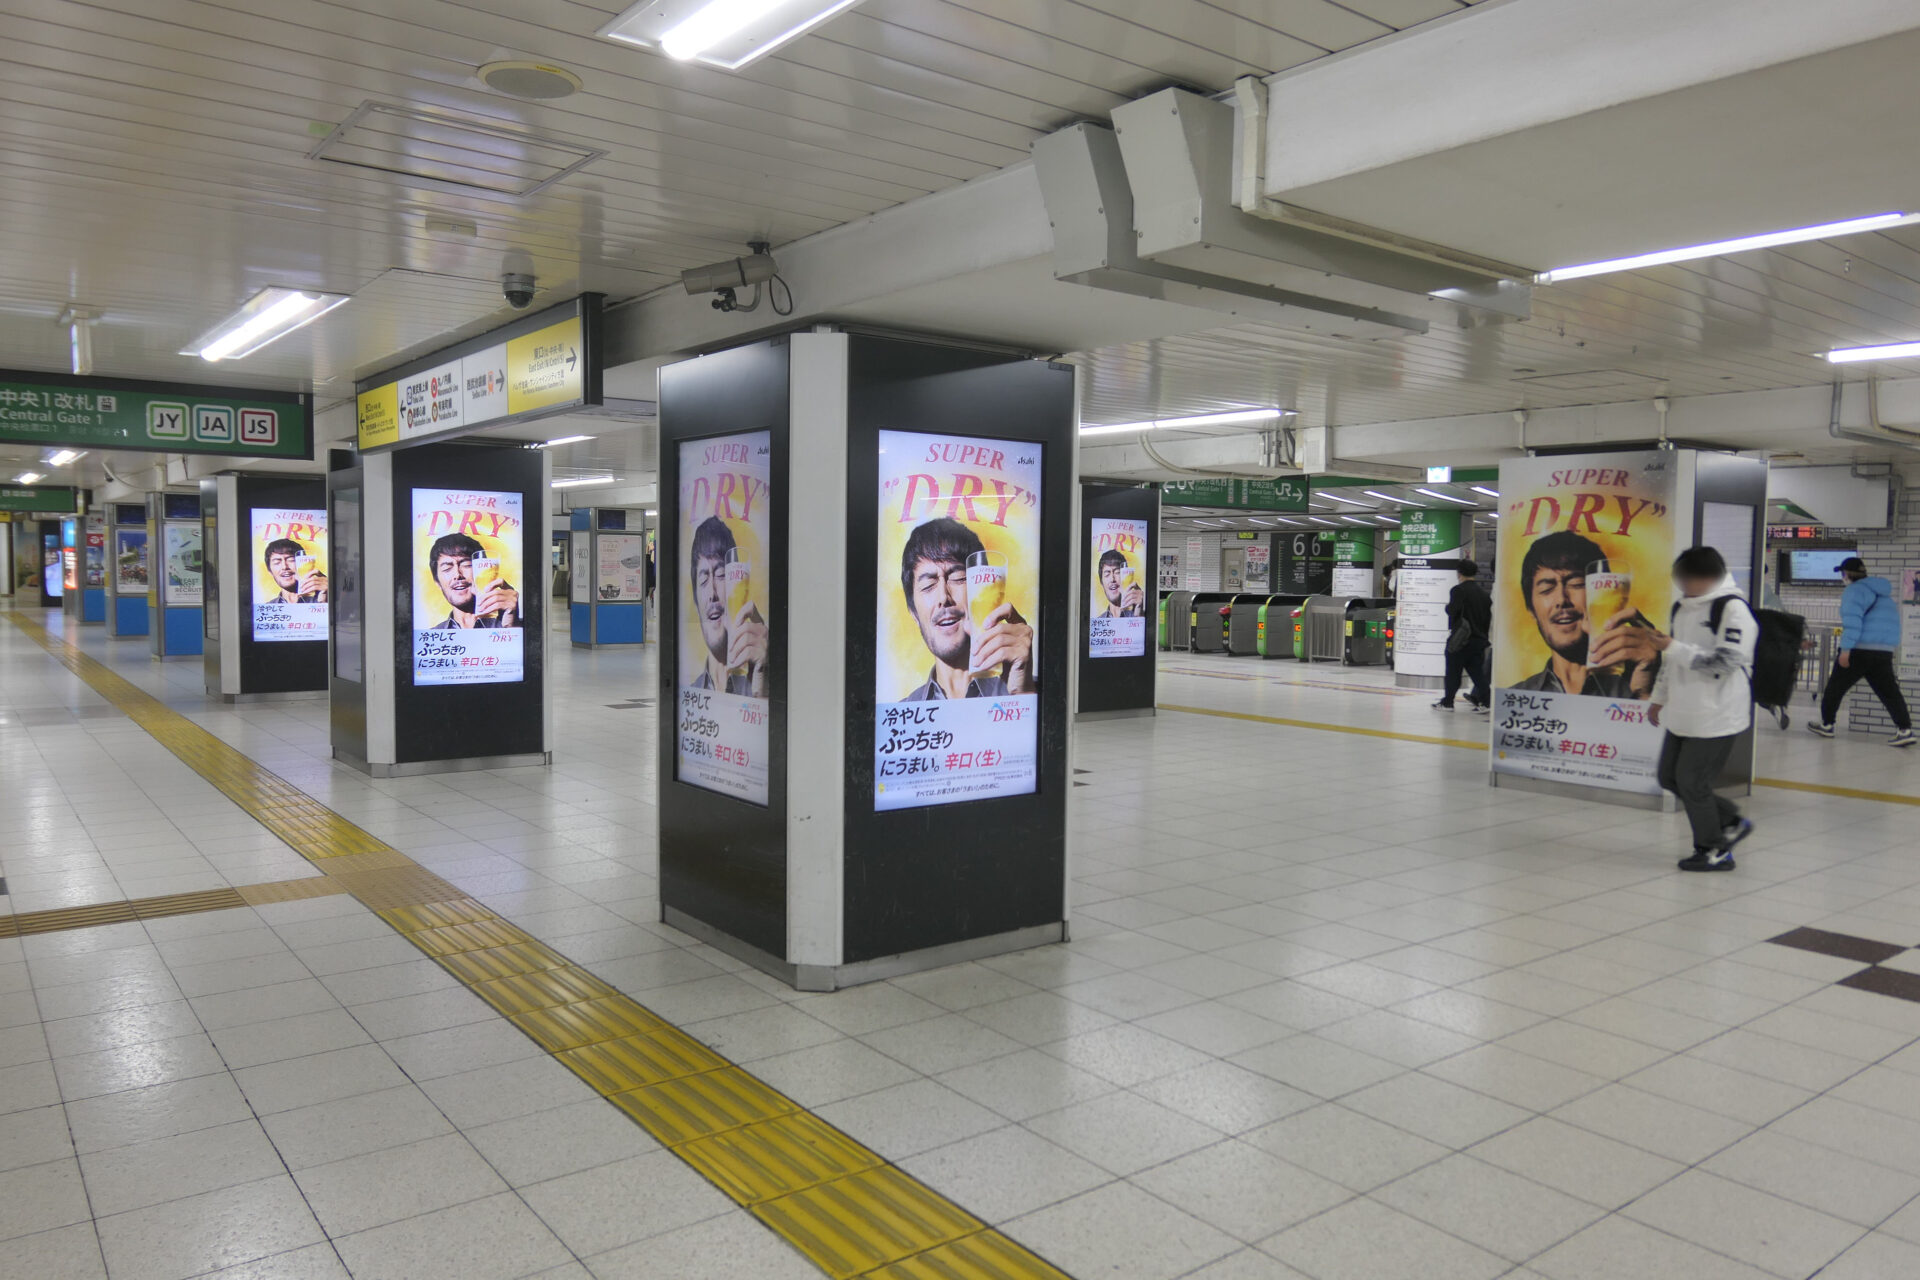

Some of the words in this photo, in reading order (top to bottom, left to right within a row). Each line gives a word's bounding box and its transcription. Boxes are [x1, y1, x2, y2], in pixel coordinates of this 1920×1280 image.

[0, 389, 94, 410] 中央1改札
[0, 408, 52, 422] Central
[57, 412, 90, 424] Gate
[96, 414, 103, 424] 1
[156, 412, 180, 429] JY
[201, 416, 226, 432] JA
[248, 418, 268, 434] JS
[702, 444, 749, 466] SUPER
[926, 443, 1004, 472] SUPER
[1018, 456, 1035, 466] Asahi
[1548, 468, 1629, 488] SUPER
[1276, 483, 1291, 496] JR
[443, 494, 496, 508] SUPER
[274, 512, 314, 522] SUPER
[1411, 512, 1423, 520] JR
[1107, 522, 1134, 532] SUPER
[1292, 534, 1306, 556] 6
[1312, 536, 1320, 556] 6
[418, 632, 456, 642] 冷やして
[417, 643, 466, 656] ぶっちぎり
[418, 658, 458, 668] にうまい。
[460, 656, 500, 667] 辛口〈生〉
[682, 690, 711, 710] 冷やして
[1502, 694, 1553, 710] 冷やして
[681, 709, 720, 738] ぶっちぎり
[882, 706, 940, 726] 冷やして
[1501, 710, 1568, 735] ぶっちぎり
[682, 736, 712, 760] にうまい。
[879, 728, 954, 754] ぶっちぎり
[1501, 733, 1555, 753] にうまい。
[1558, 740, 1618, 760] 辛口〈生〉
[880, 757, 940, 777] にうまい。
[944, 750, 1003, 770] 辛口〈生〉
